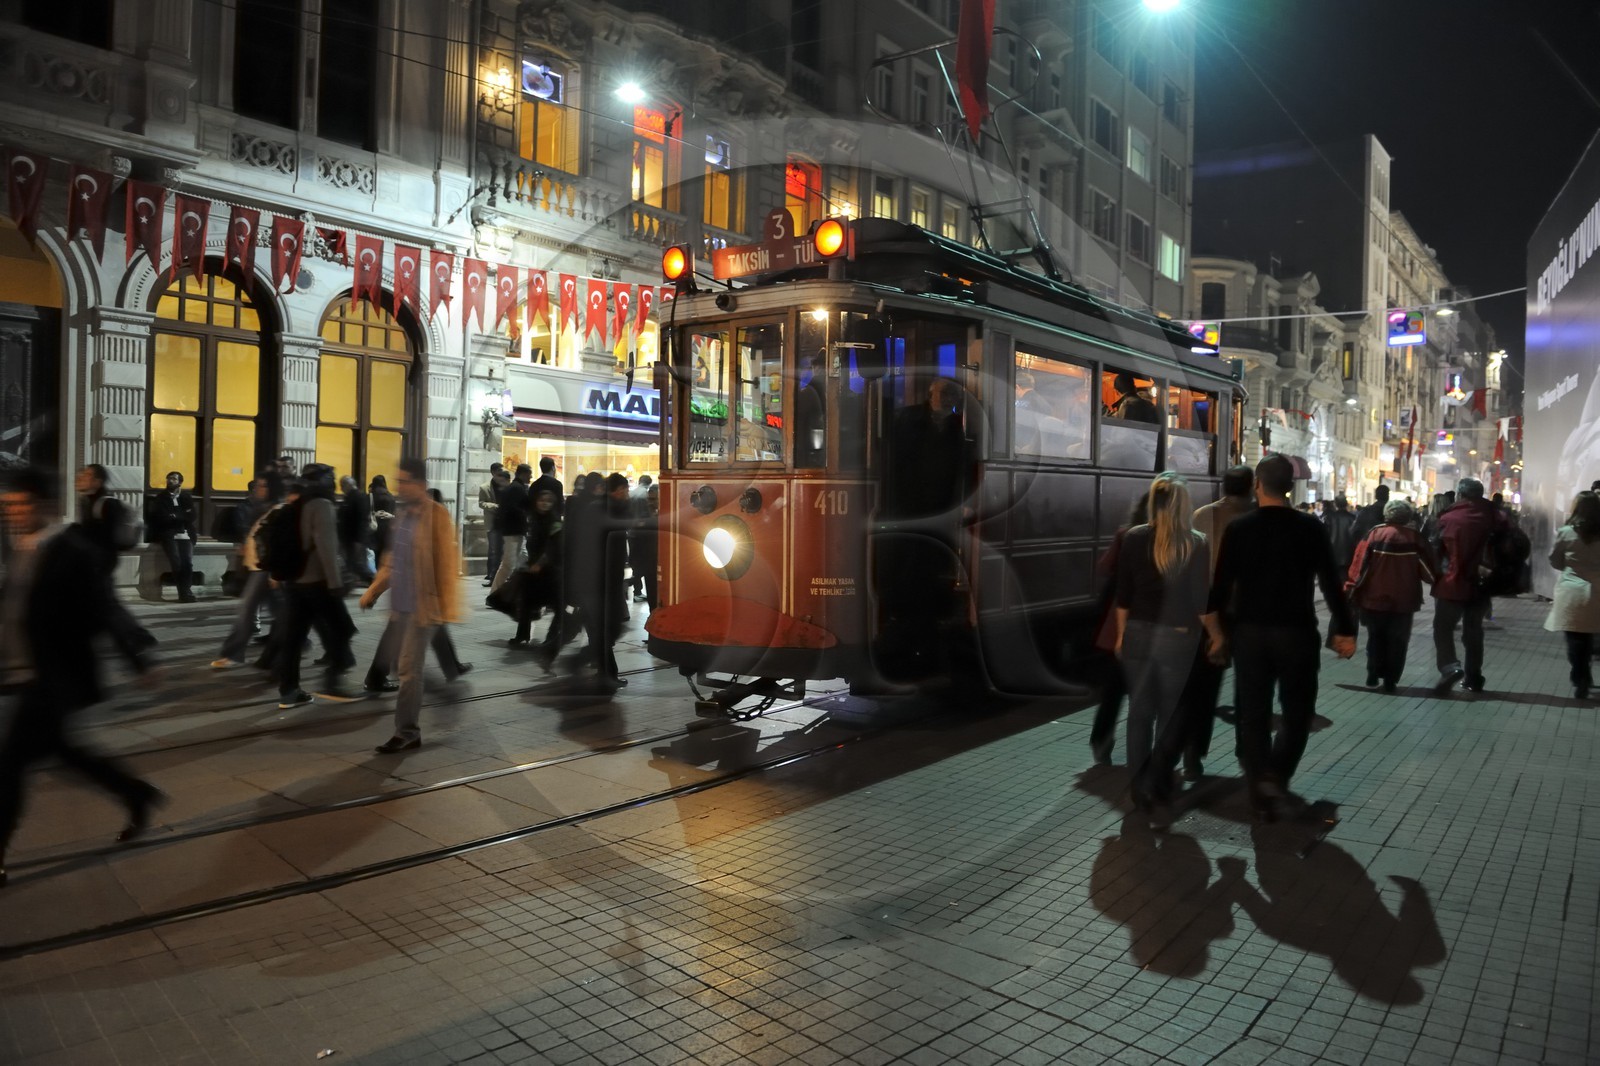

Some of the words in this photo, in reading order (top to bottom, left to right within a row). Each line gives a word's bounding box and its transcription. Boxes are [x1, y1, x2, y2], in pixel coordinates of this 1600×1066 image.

[772, 214, 785, 240] 3
[727, 247, 770, 274] TAKSİM
[814, 490, 848, 515] 410
[810, 587, 818, 596] VE
[811, 577, 837, 585] ASILMAK
